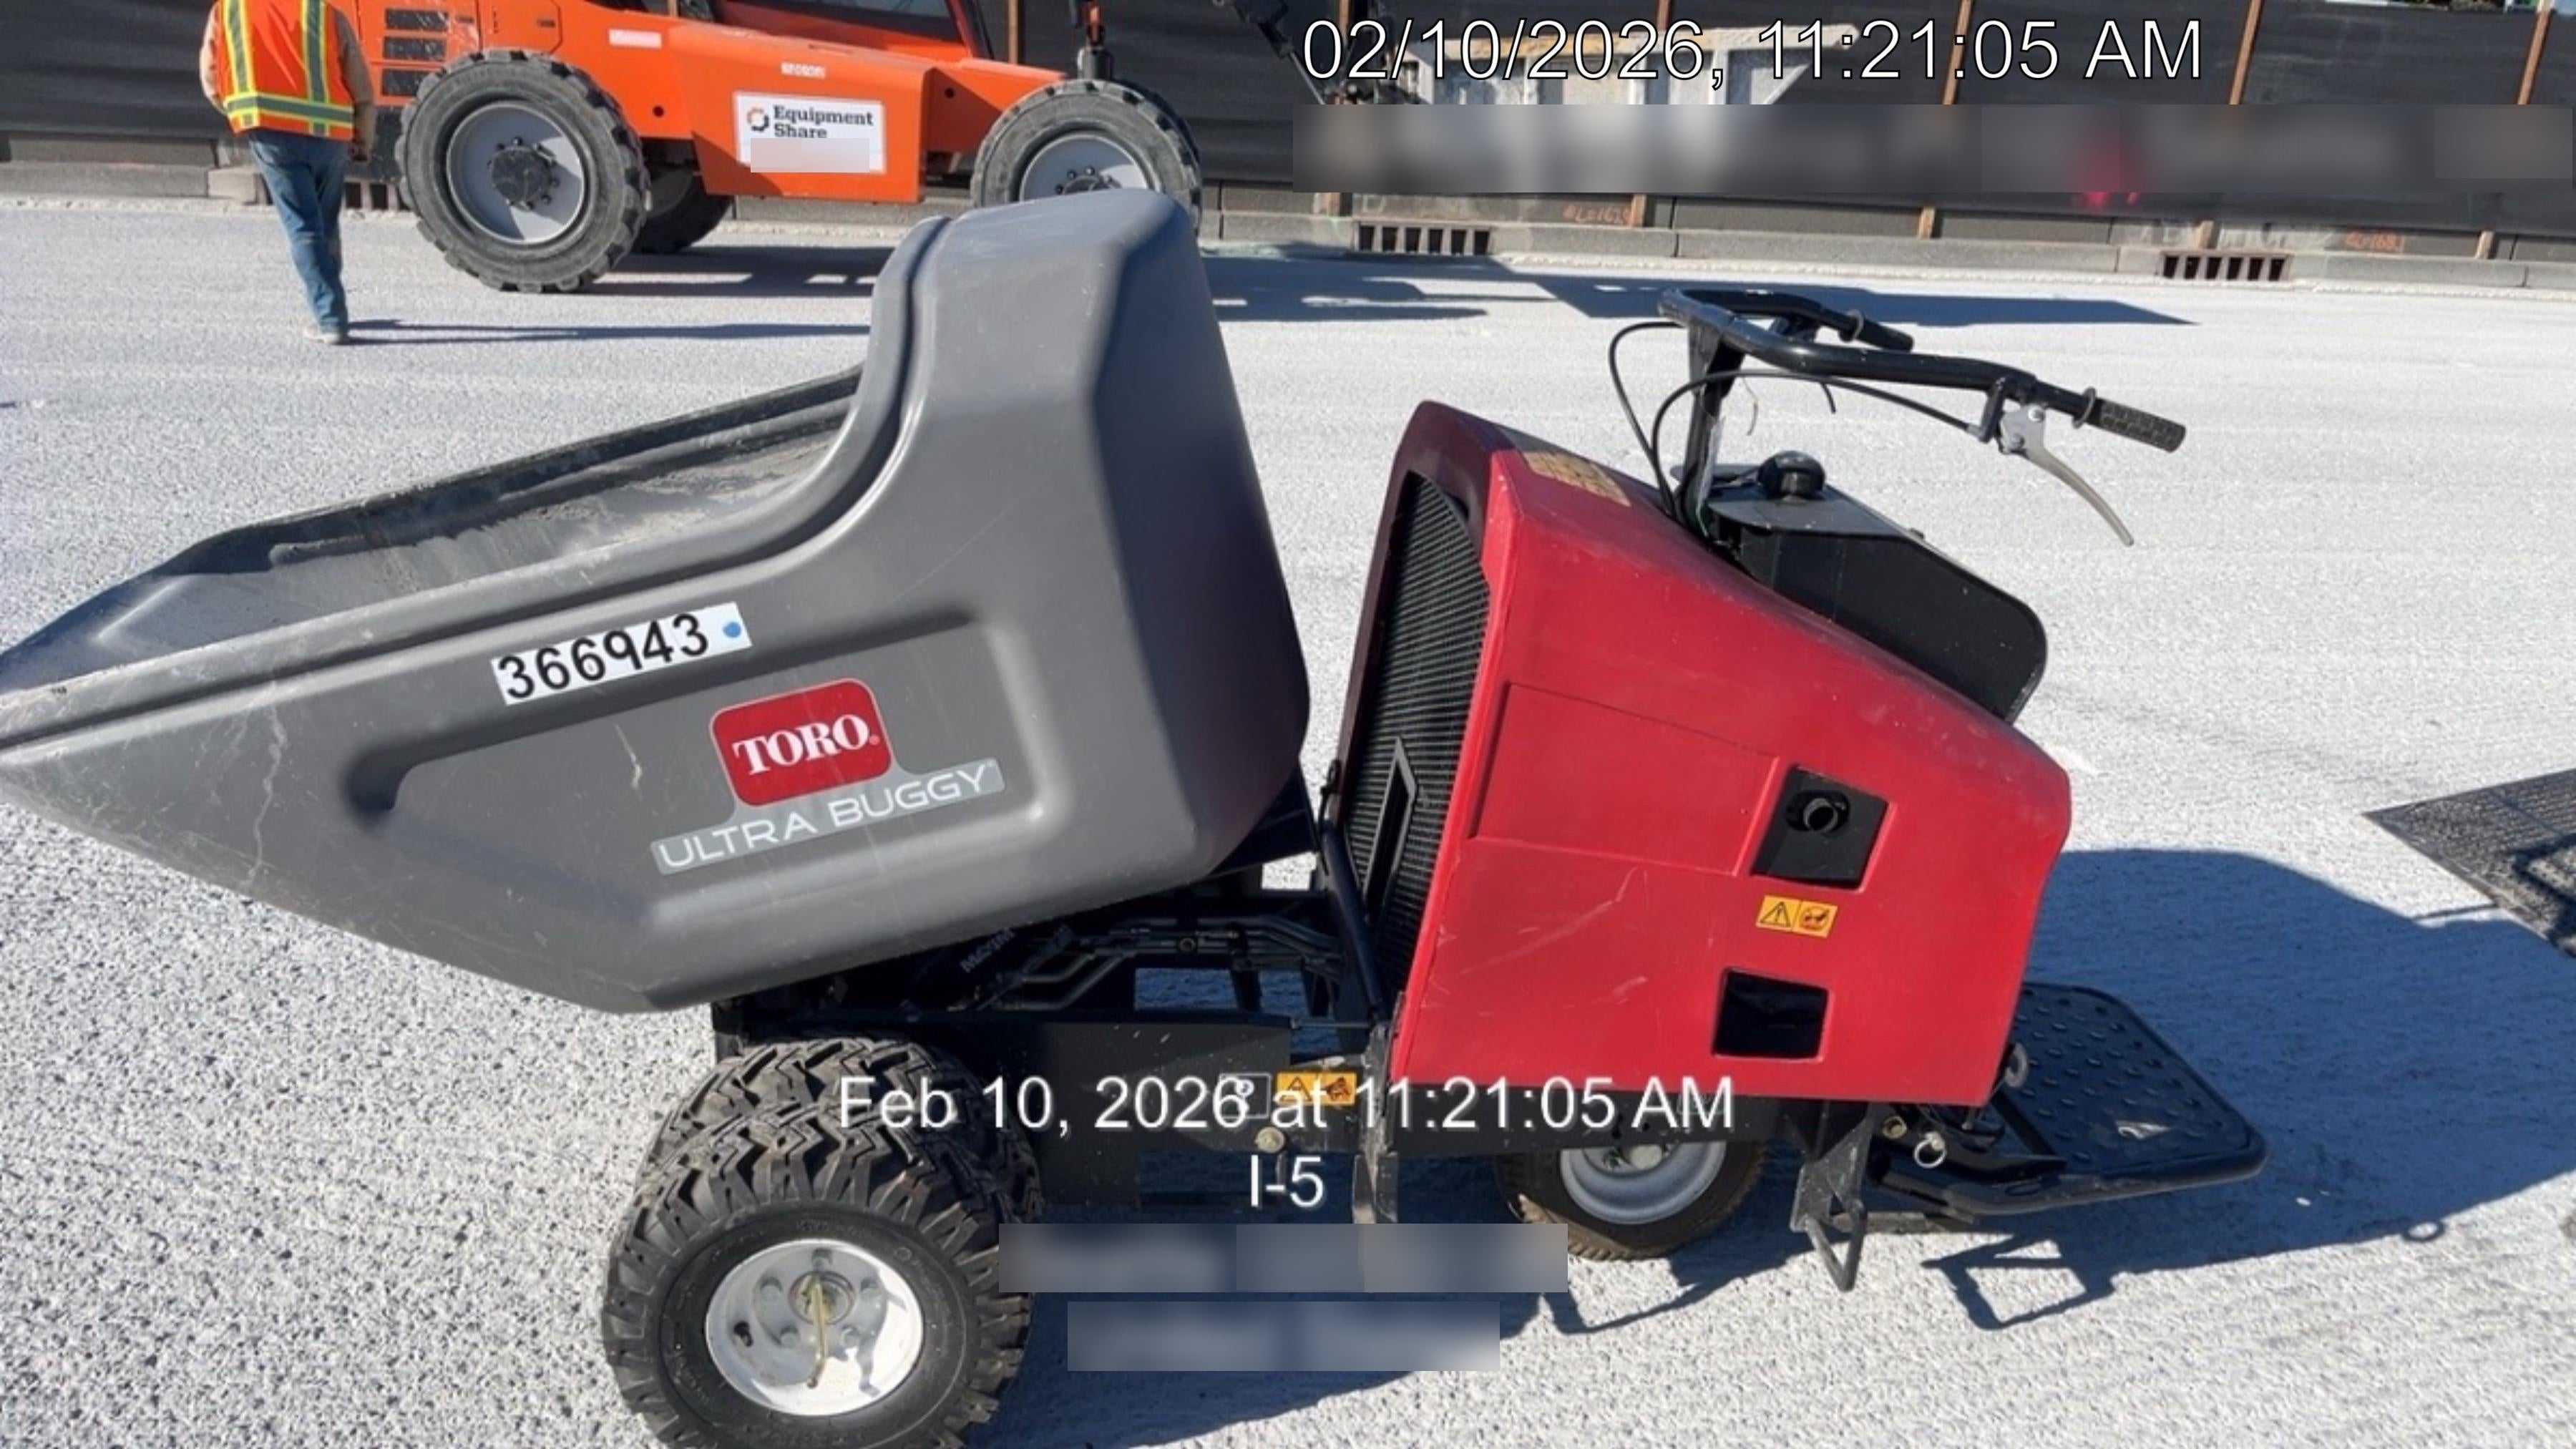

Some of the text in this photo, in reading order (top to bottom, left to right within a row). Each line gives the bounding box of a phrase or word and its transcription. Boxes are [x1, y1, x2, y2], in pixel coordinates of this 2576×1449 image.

[773, 105, 874, 126] Equipment
[774, 122, 827, 139] Share
[497, 613, 709, 699] 366943
[658, 763, 987, 868] ULTRA BUGGY
